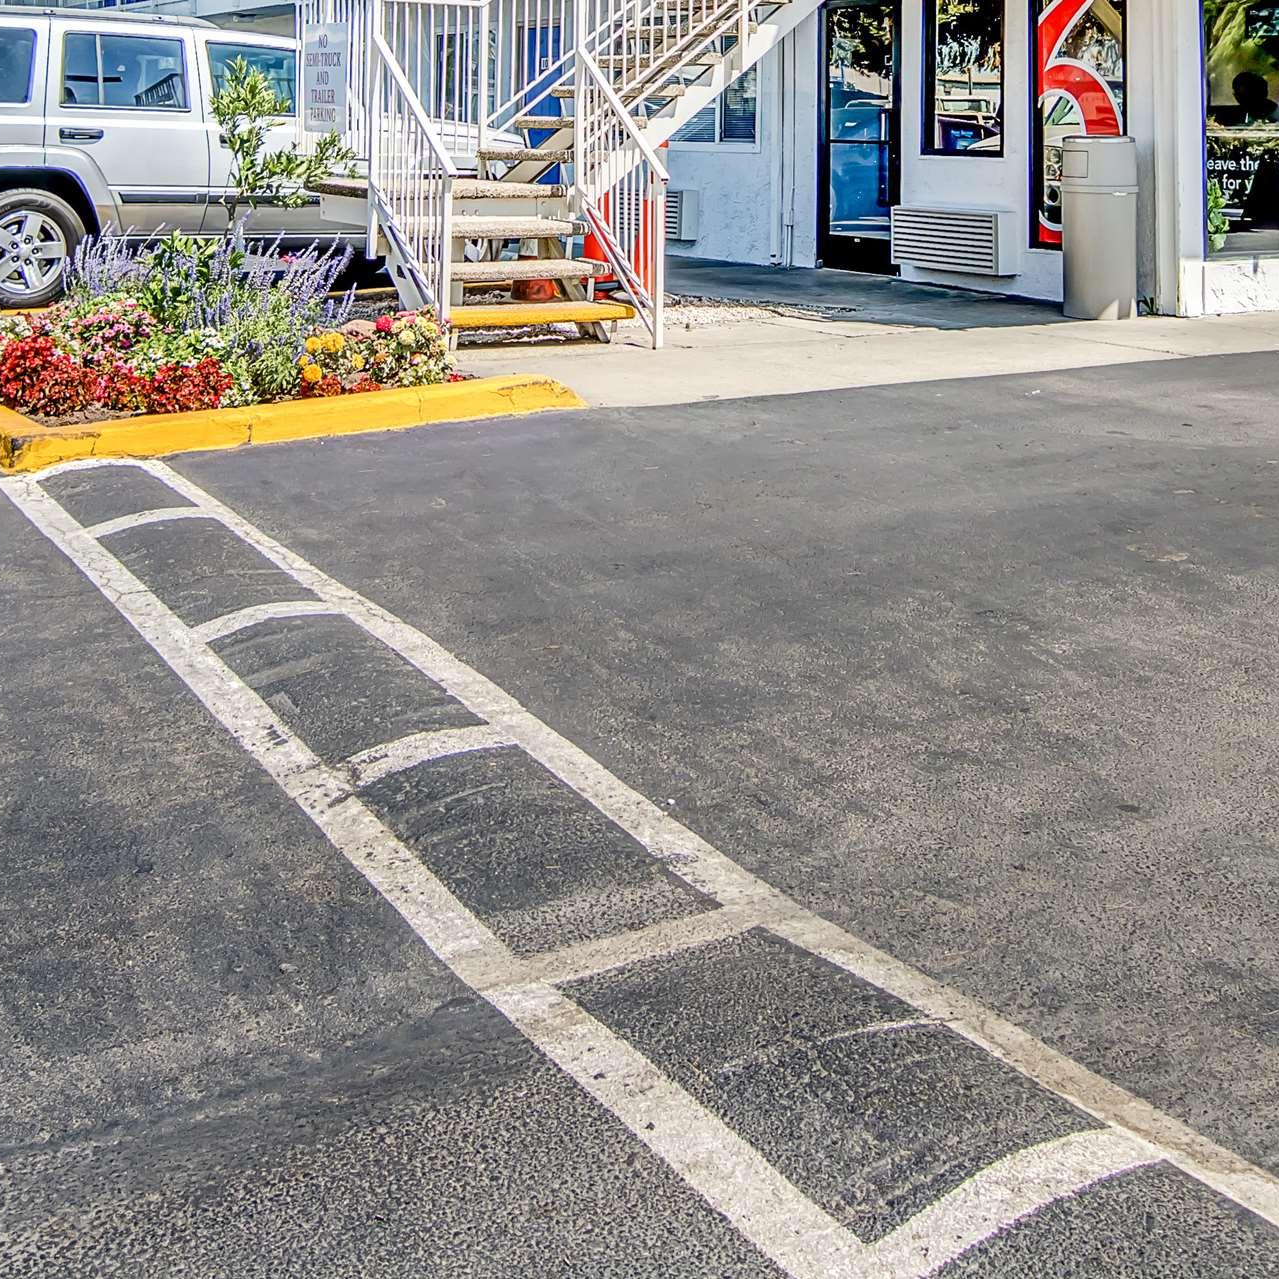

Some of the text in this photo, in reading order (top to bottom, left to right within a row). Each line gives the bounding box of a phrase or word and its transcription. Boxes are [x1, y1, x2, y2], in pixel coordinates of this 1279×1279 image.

[318, 34, 328, 49] NO
[316, 70, 329, 86] AND
[311, 89, 336, 104] TRAILER
[310, 107, 336, 122] PARKING
[1207, 159, 1236, 171] eave
[1222, 173, 1241, 190] for
